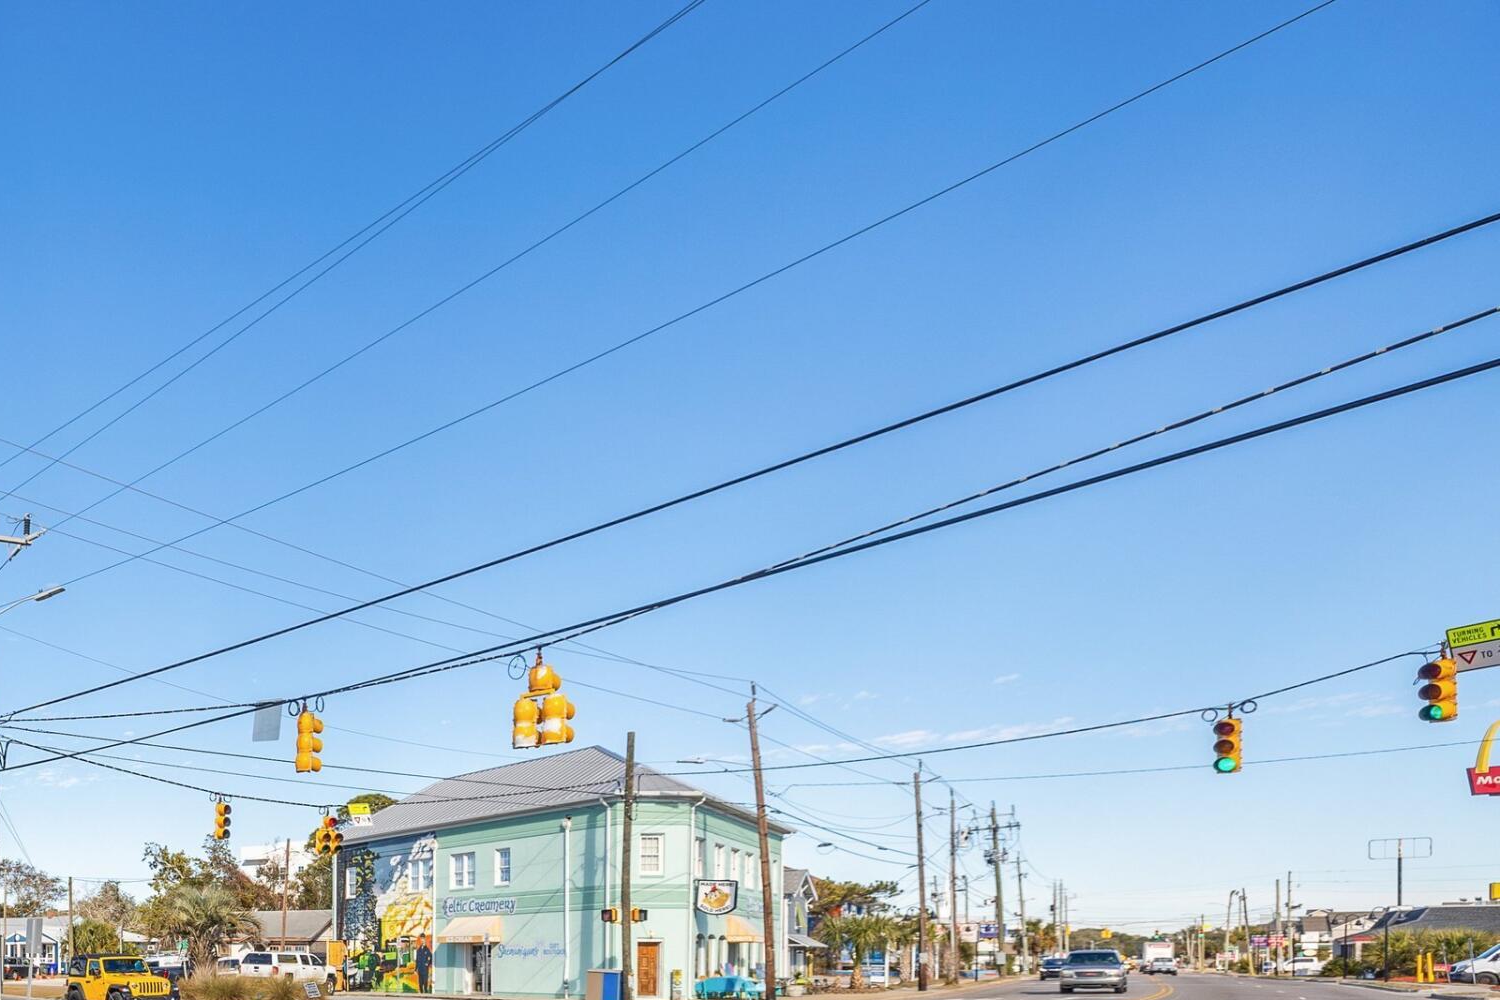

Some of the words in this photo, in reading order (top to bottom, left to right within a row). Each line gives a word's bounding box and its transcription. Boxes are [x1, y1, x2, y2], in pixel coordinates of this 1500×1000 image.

[1452, 627, 1484, 637] TURNING
[1452, 632, 1487, 644] VEHICLES
[1481, 650, 1493, 658] TO
[443, 896, 467, 917] Celtic
[468, 899, 516, 914] Creamery
